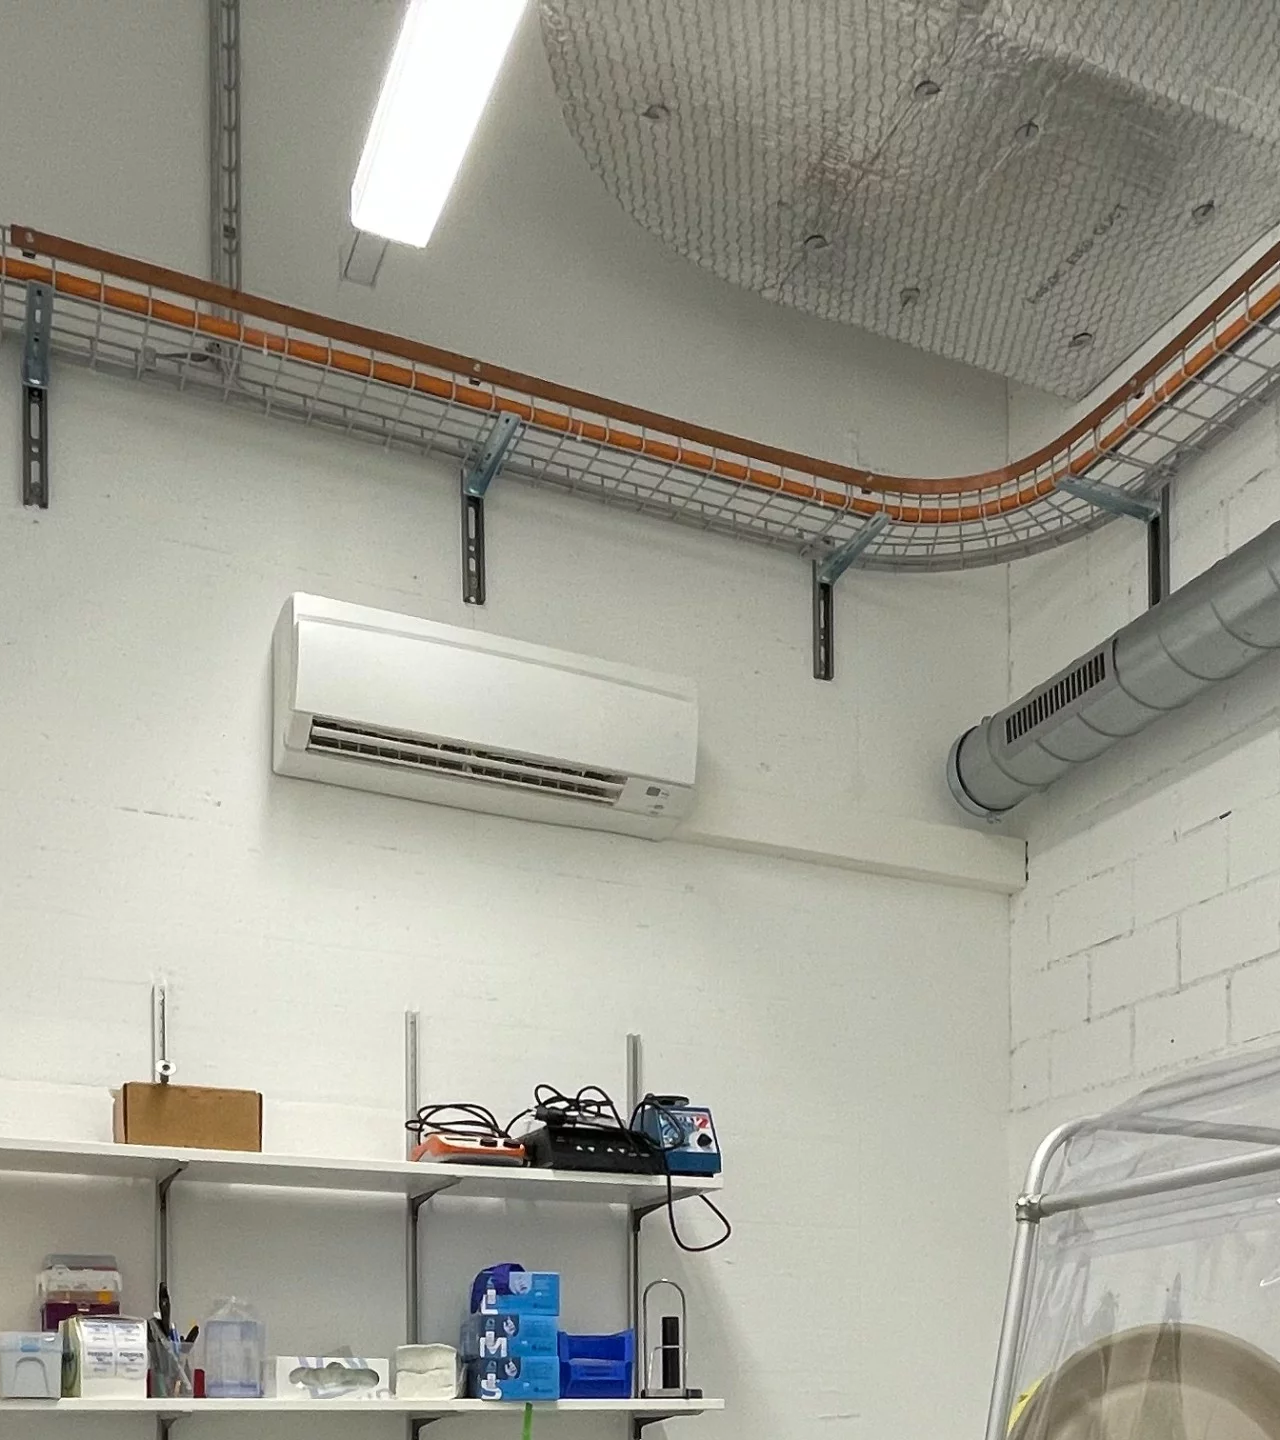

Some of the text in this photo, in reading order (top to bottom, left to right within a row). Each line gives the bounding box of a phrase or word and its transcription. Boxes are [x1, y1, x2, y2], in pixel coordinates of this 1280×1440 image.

[481, 1294, 498, 1314] L
[479, 1336, 508, 1358] M
[481, 1379, 502, 1400] S
